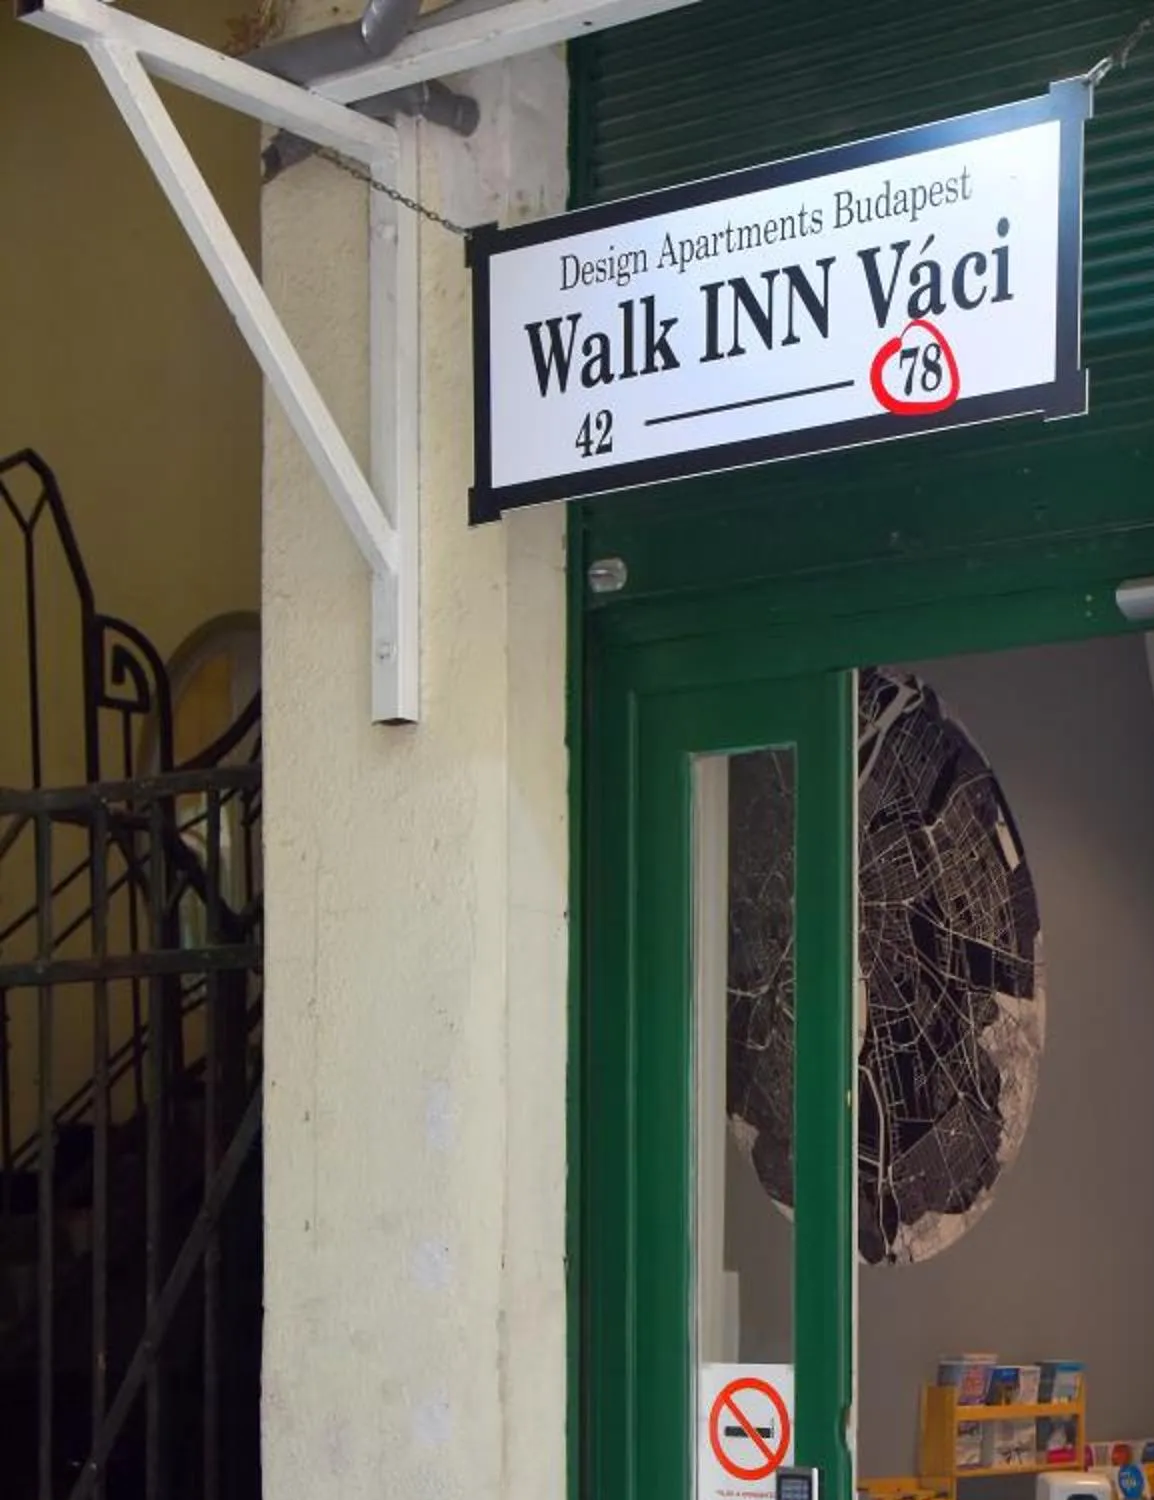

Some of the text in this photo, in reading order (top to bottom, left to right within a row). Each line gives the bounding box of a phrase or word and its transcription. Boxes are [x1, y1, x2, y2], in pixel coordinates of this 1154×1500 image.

[560, 165, 973, 292] Design Apartments Budapest
[524, 216, 1014, 397] Walk INN Váci
[574, 342, 942, 458] 42 78
